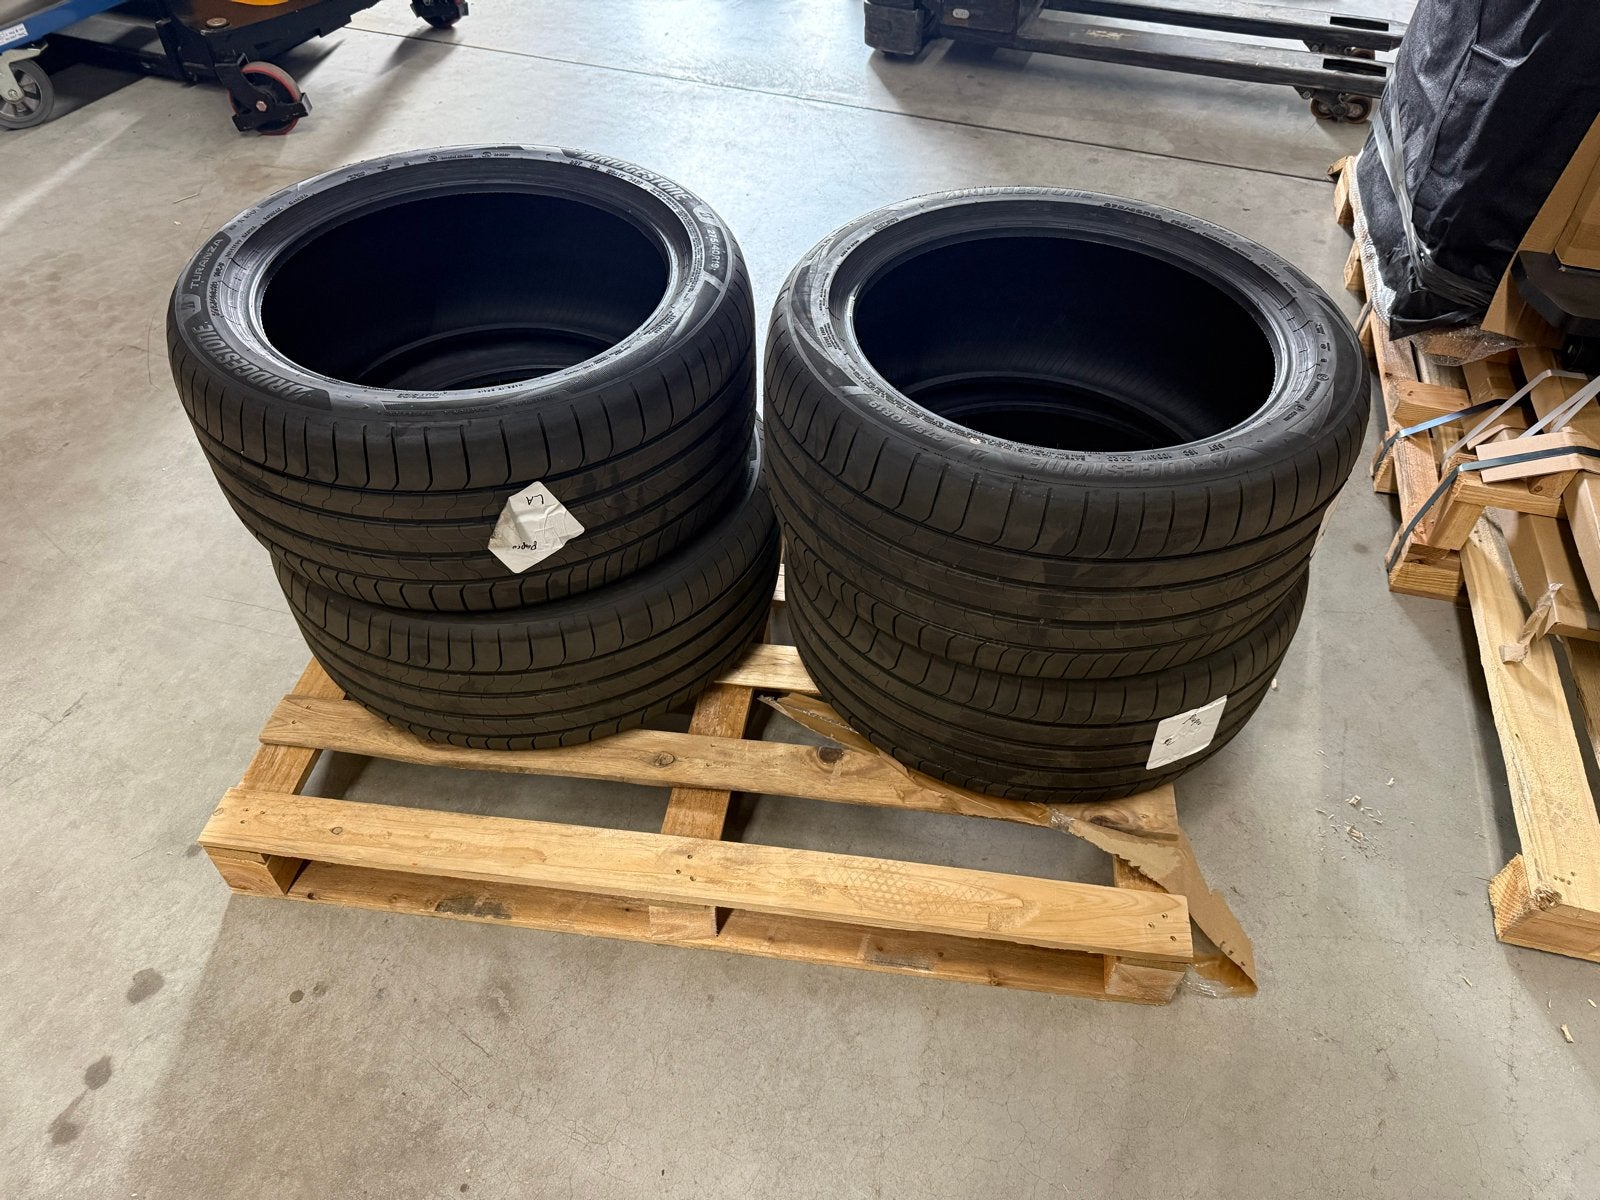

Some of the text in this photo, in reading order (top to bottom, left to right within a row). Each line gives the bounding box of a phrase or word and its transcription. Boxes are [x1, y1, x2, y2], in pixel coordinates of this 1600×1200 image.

[580, 151, 693, 203] BRIDGESTONE
[190, 237, 223, 289] TURANZA
[706, 228, 721, 271] 275/40R19
[191, 321, 313, 405] BRIDGESTONE
[868, 398, 946, 442] 275/40R19
[525, 493, 545, 506] LA
